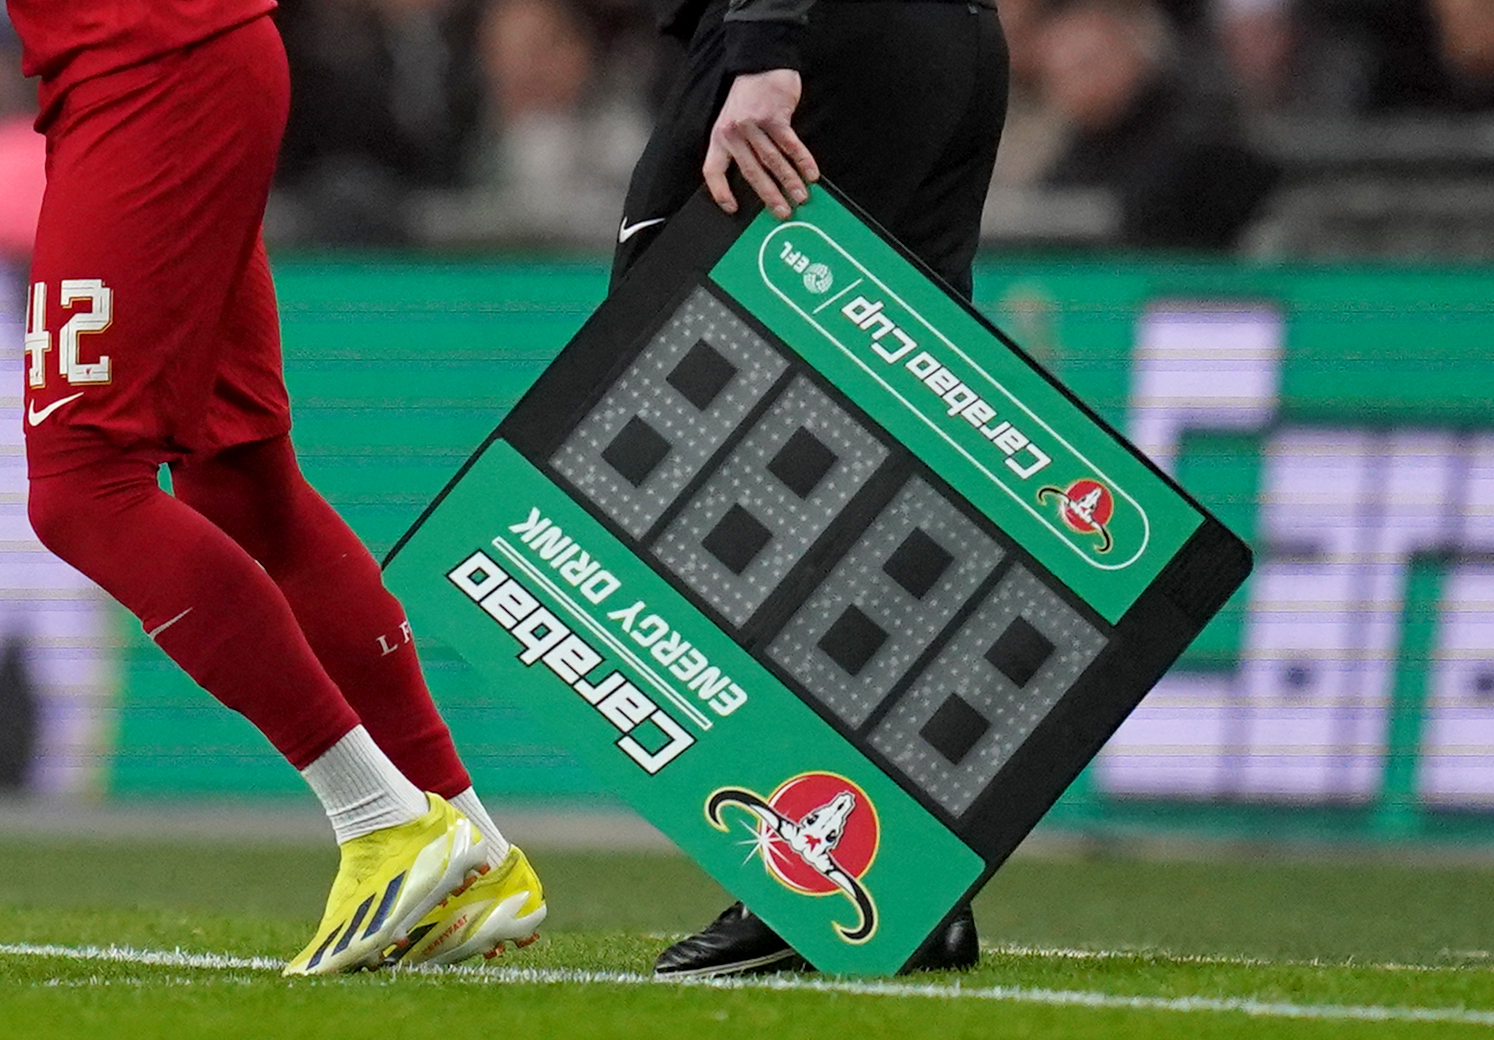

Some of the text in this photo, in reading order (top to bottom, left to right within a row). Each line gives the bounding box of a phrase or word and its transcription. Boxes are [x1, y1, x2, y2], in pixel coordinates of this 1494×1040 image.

[24, 279, 114, 388] 42
[779, 241, 810, 274] EFL
[841, 295, 1052, 480] Carabao Cup
[446, 548, 698, 776] Carabao
[508, 507, 748, 717] ENERGY DRINK
